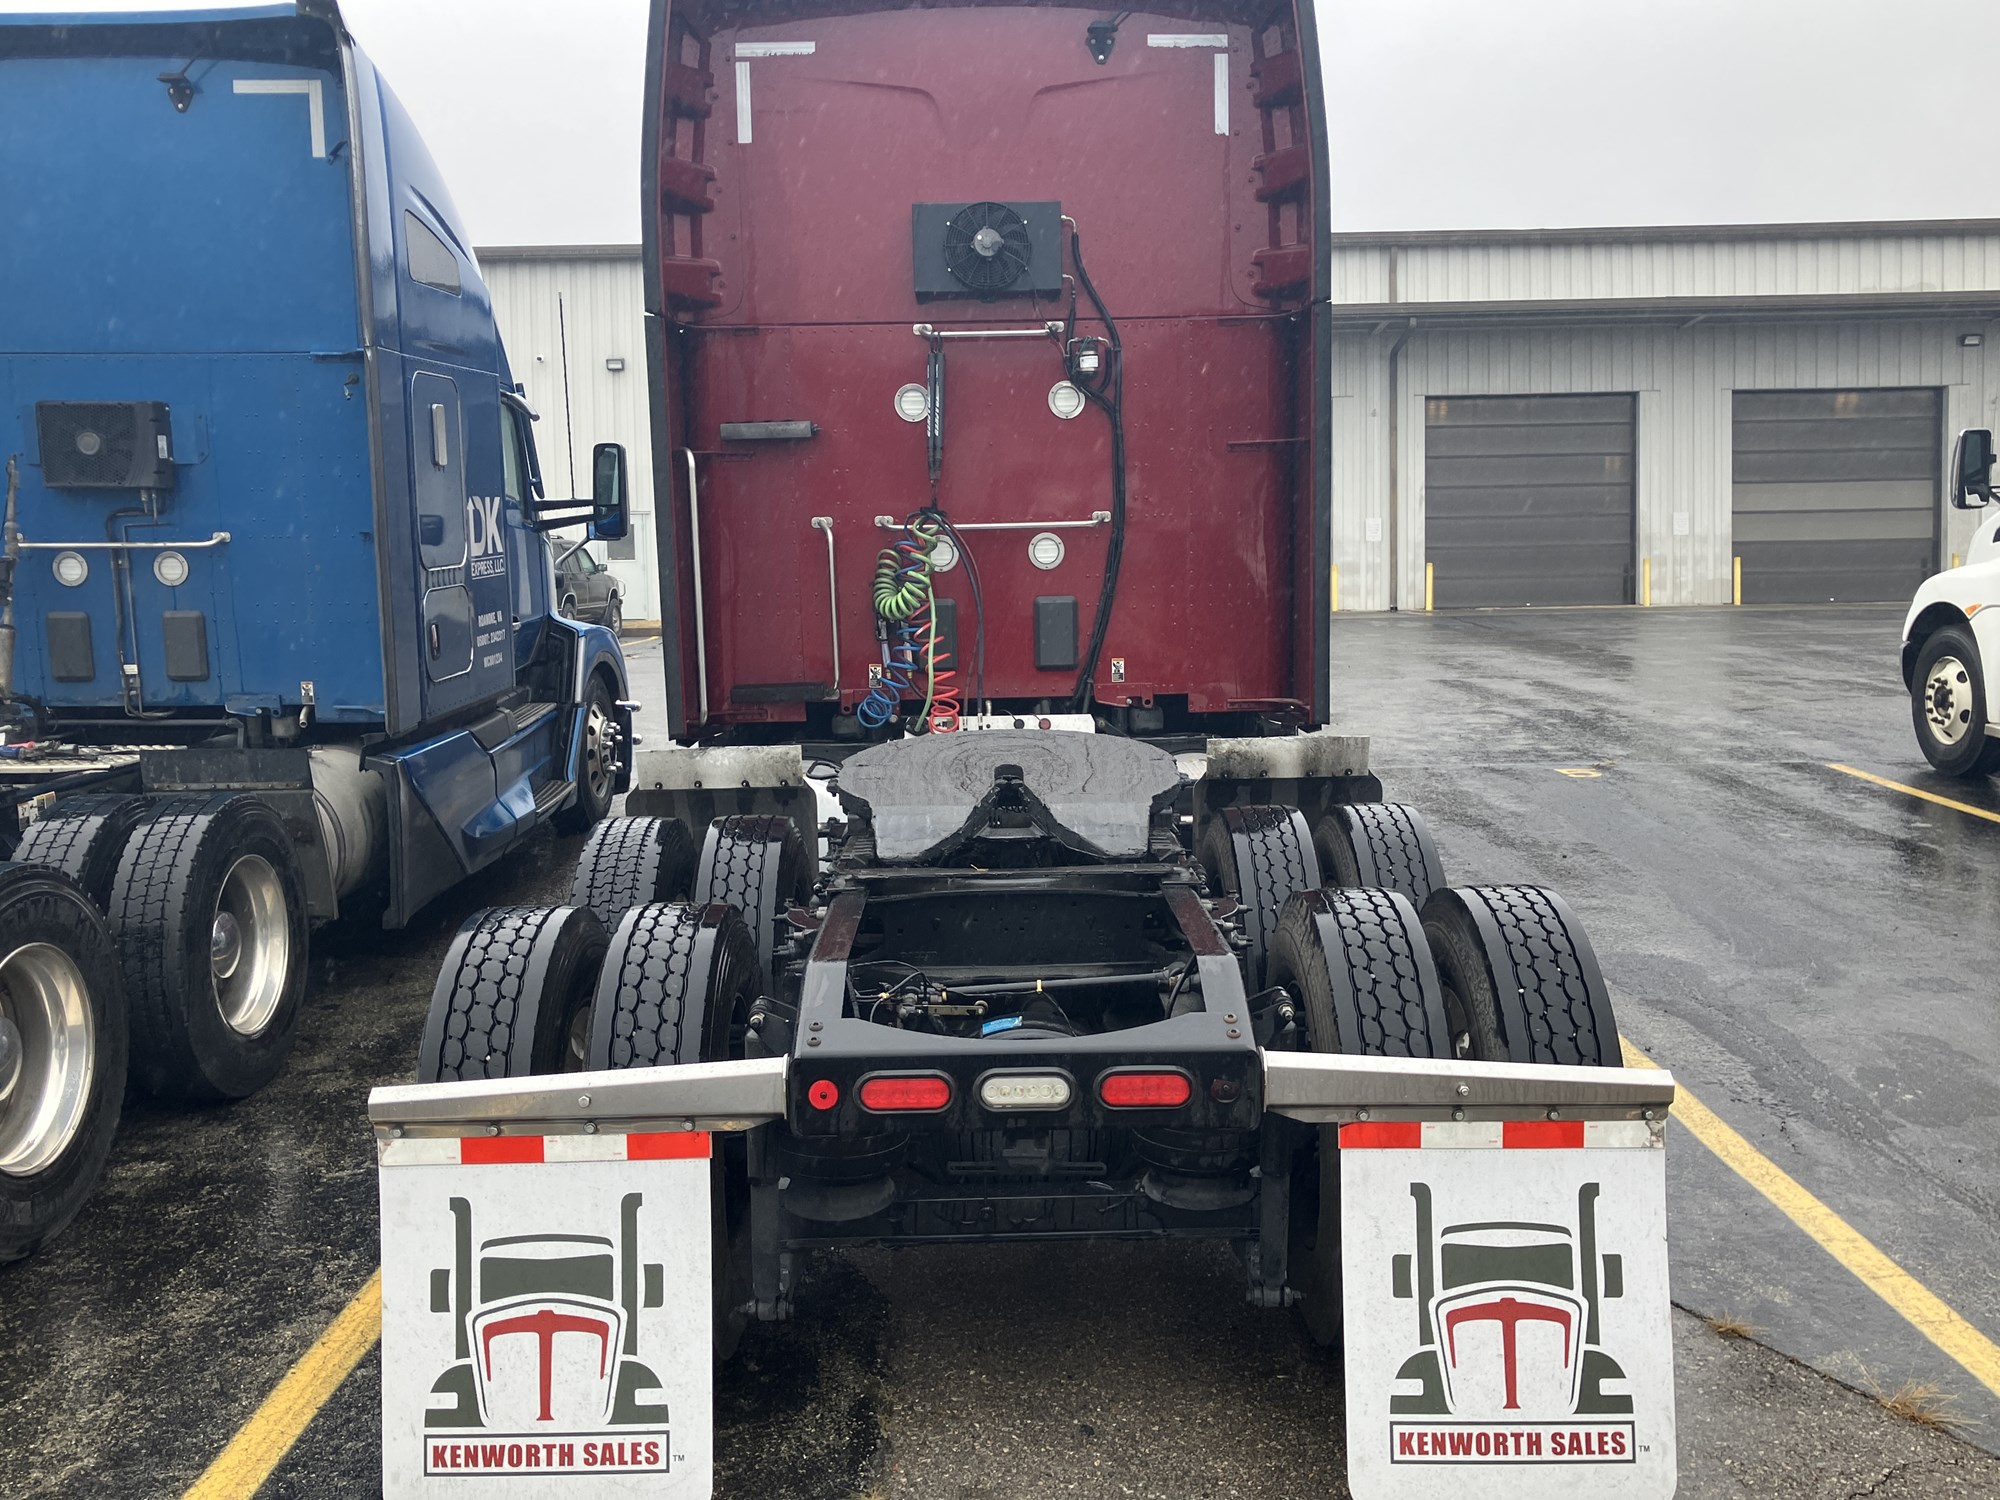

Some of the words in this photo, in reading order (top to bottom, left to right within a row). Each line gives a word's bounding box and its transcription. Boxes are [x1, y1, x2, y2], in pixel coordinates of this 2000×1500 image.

[466, 495, 504, 556] DK
[472, 561, 495, 576] EXPRESS,
[432, 1443, 574, 1468] KENWORTH
[583, 1441, 660, 1466] SALES
[1399, 1431, 1542, 1456] KENWORTH
[1551, 1430, 1626, 1456] SALES
